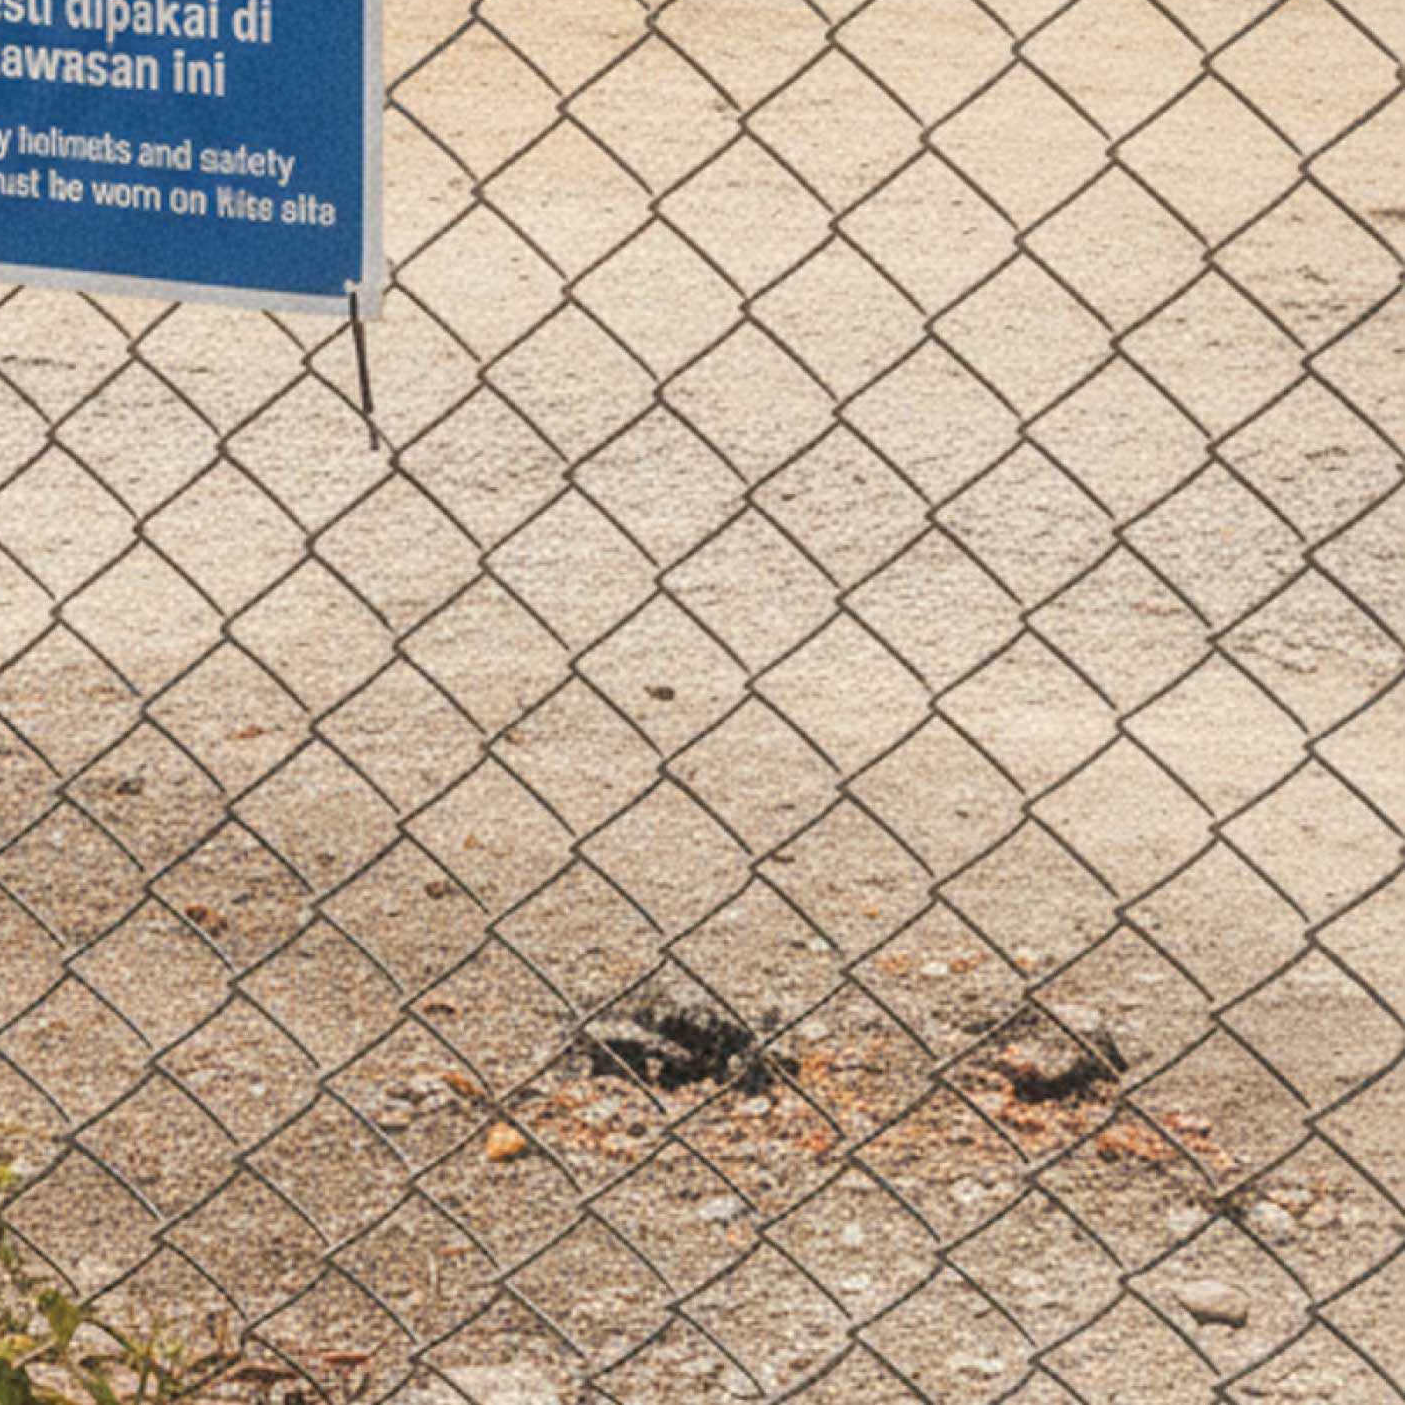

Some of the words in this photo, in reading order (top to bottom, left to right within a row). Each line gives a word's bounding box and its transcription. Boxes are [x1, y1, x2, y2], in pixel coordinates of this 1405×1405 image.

[174, 49, 224, 96] ini
[138, 140, 191, 170] and
[170, 188, 207, 215] on
